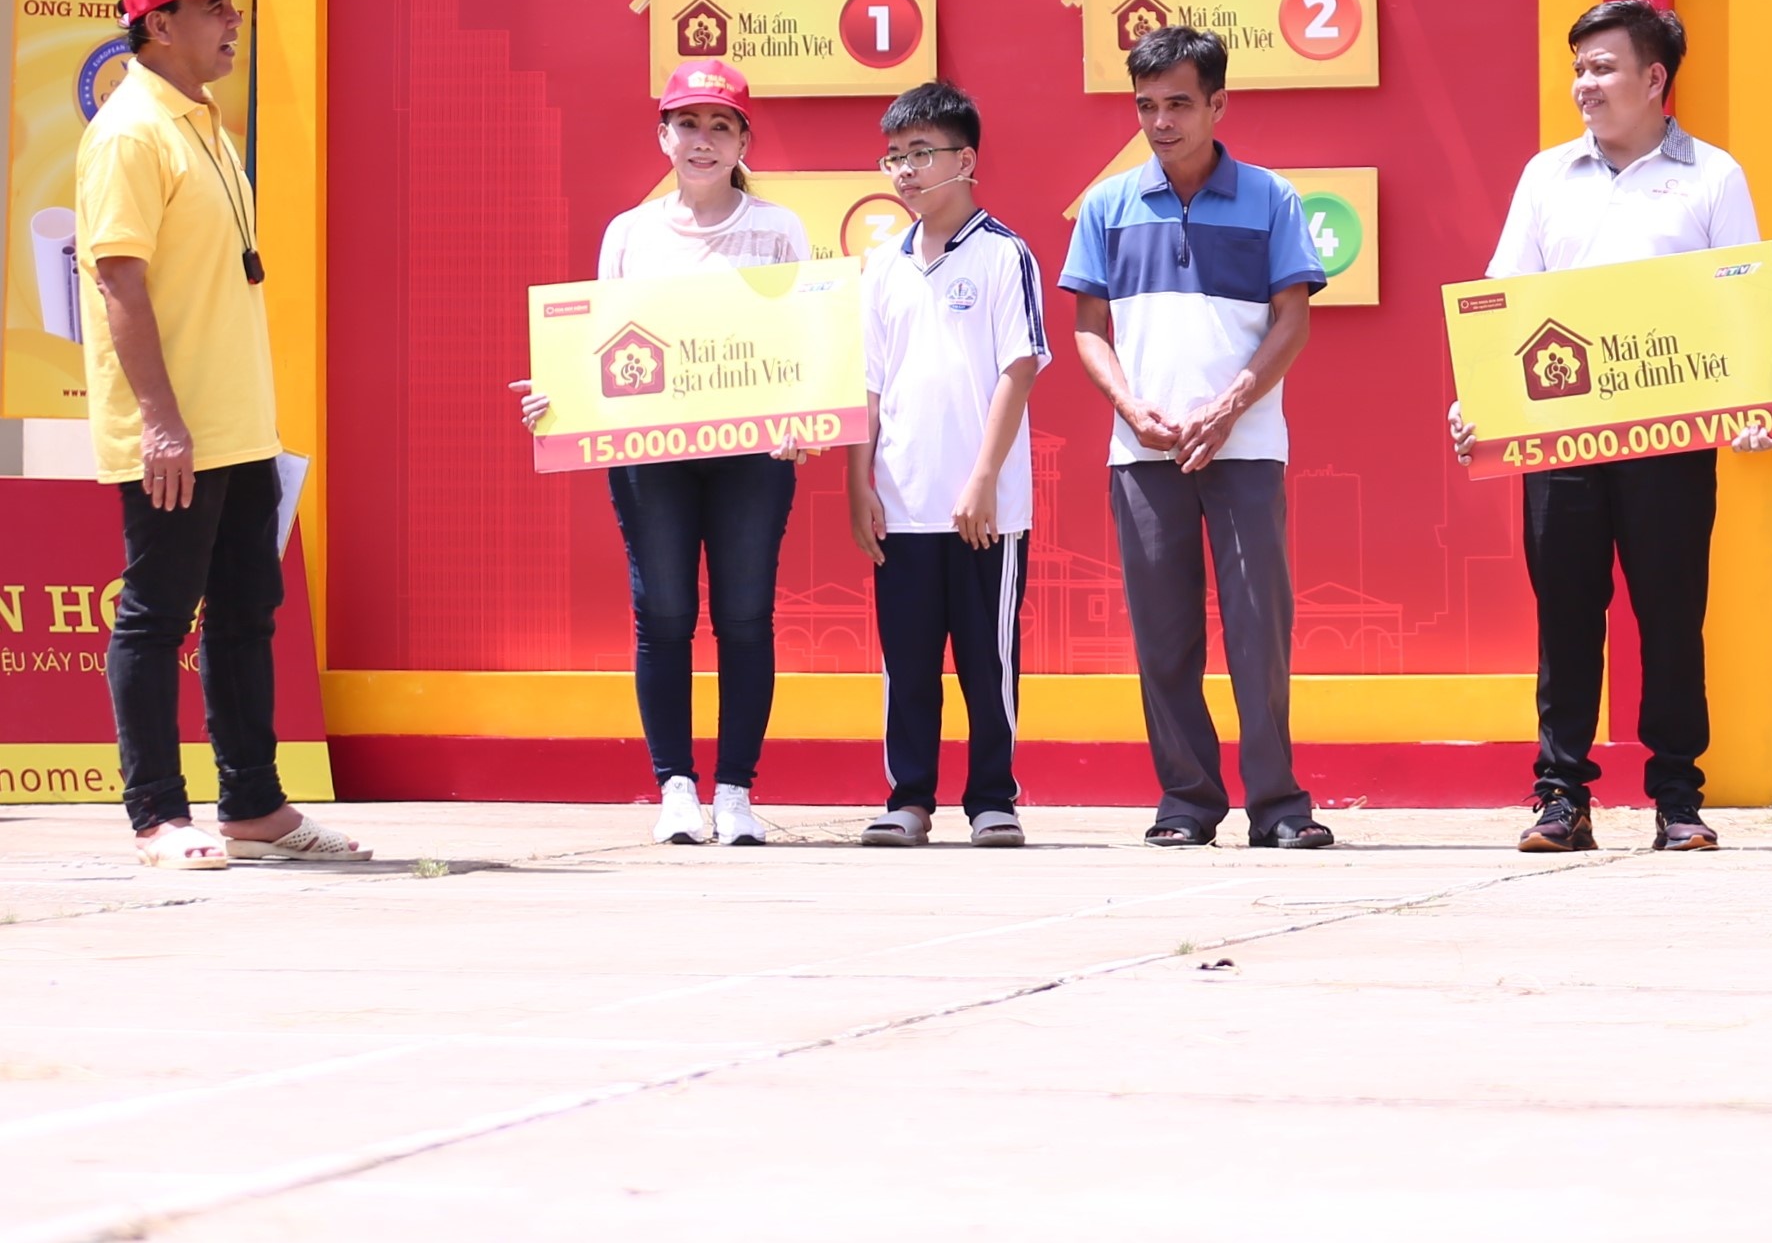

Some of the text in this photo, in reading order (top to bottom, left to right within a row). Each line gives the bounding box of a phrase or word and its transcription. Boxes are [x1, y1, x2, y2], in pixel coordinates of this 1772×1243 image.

[738, 11, 797, 35] Mái ấm
[867, 6, 891, 51] 1
[1178, 4, 1238, 28] Mái ấm
[732, 34, 835, 63] gia đình Việt
[1241, 26, 1275, 52] Việt
[1308, 211, 1340, 257] 4
[679, 333, 755, 365] Mái ấm
[1600, 327, 1680, 364] Mái ấm
[672, 369, 703, 400] gia
[761, 357, 803, 387] Việt
[1597, 352, 1731, 401] gia đình Việt
[577, 413, 842, 464] 15.000.000 VNĐ
[1502, 419, 1691, 467] 45.000.000
[31, 647, 72, 673] XÂY
